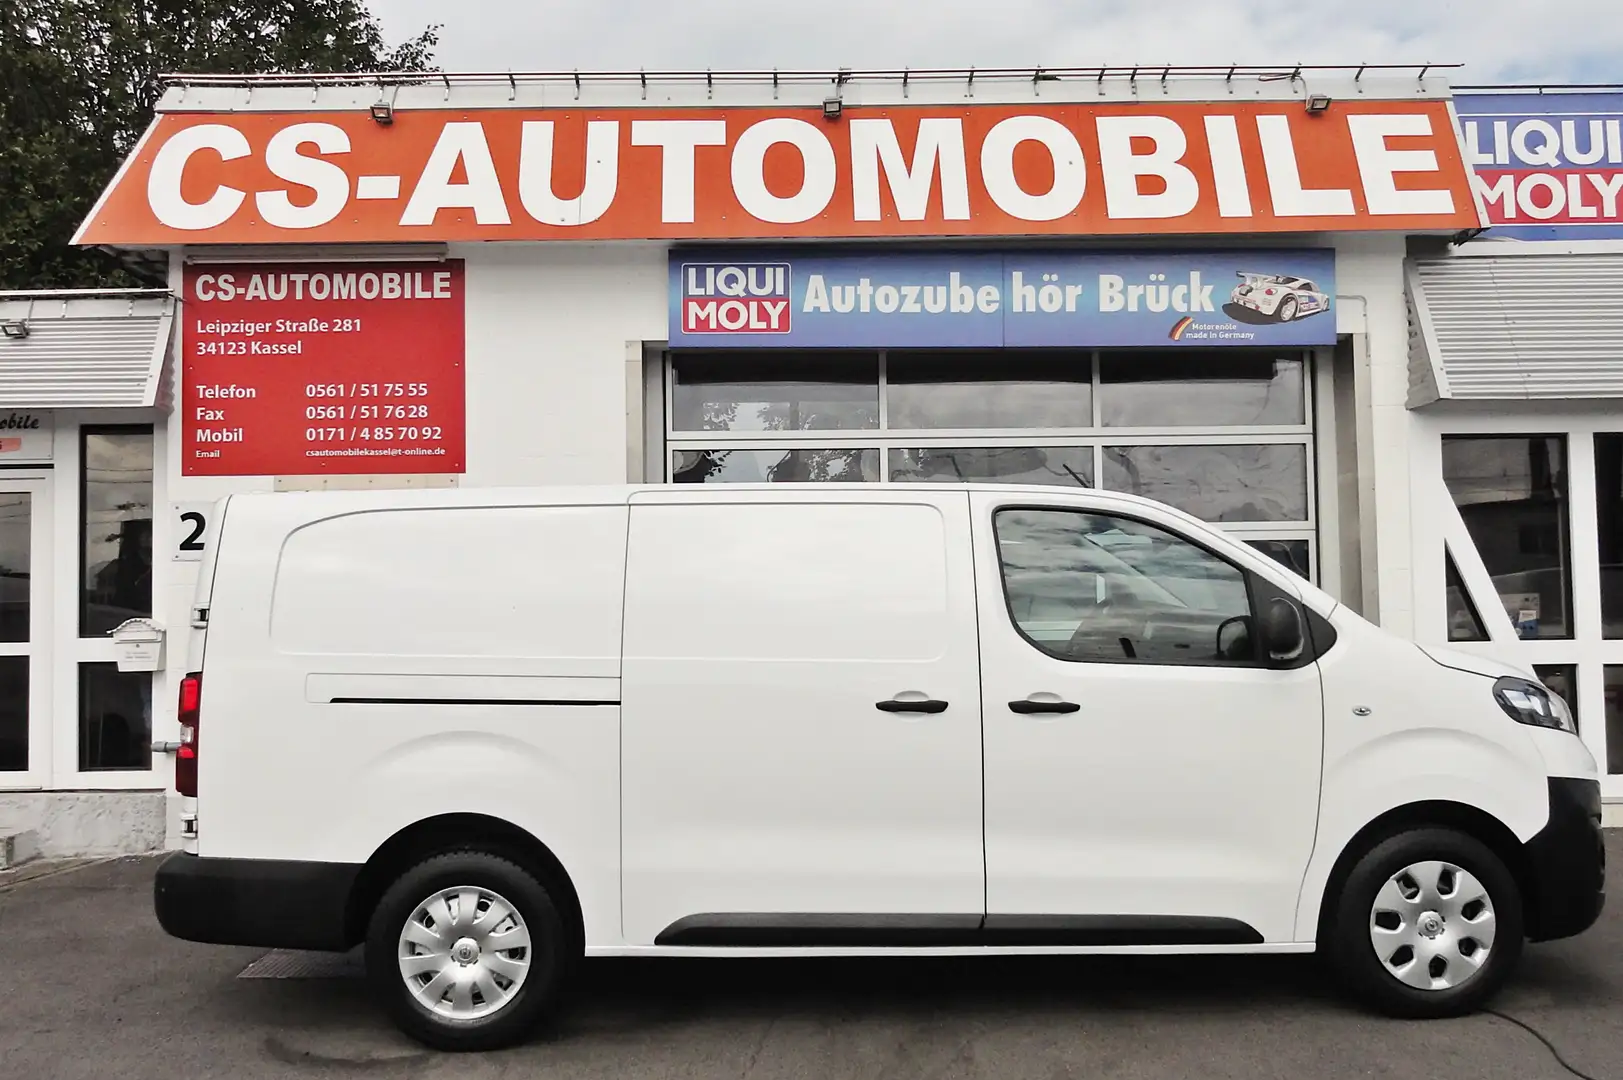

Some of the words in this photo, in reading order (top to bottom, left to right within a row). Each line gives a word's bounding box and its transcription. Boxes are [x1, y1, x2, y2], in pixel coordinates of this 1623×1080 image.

[1464, 119, 1622, 168] LIQUI
[147, 114, 1455, 230] CS-AUTOMOBILE
[1474, 172, 1623, 219] MOLY
[195, 272, 452, 301] CS-AUTOMOBILE
[687, 266, 785, 298] LIQUI
[803, 272, 1000, 313] Autozube
[1012, 271, 1082, 313] hör
[1099, 271, 1215, 313] Brück
[687, 300, 789, 330] MOLY
[197, 319, 272, 336] Leipziger
[275, 318, 329, 332] Straße
[332, 318, 361, 332] 281
[1186, 331, 1208, 339] made
[1219, 331, 1255, 340] Germany
[1192, 323, 1237, 331] Motorenöle
[196, 341, 247, 355] 34123
[251, 340, 302, 354] Kassel
[196, 384, 256, 399] Telefon
[305, 384, 345, 397] 0561
[349, 383, 357, 398] /
[360, 383, 379, 397] 51
[384, 383, 404, 397] 75
[408, 383, 428, 396] 55
[196, 407, 225, 421] Fax
[305, 406, 345, 419] 0561
[349, 405, 357, 420] /
[360, 405, 379, 419] 51
[384, 405, 406, 419] 76
[408, 405, 428, 418] 28
[196, 428, 243, 442] Mobil
[305, 428, 346, 441] 0171
[349, 427, 357, 441] /
[360, 427, 370, 441] 4
[373, 427, 394, 440] 85
[397, 427, 418, 440] 70
[421, 426, 442, 440] 92
[195, 449, 220, 458] Email
[305, 447, 446, 457] csautomobilekassel@t-online.de
[179, 511, 206, 551] 2
